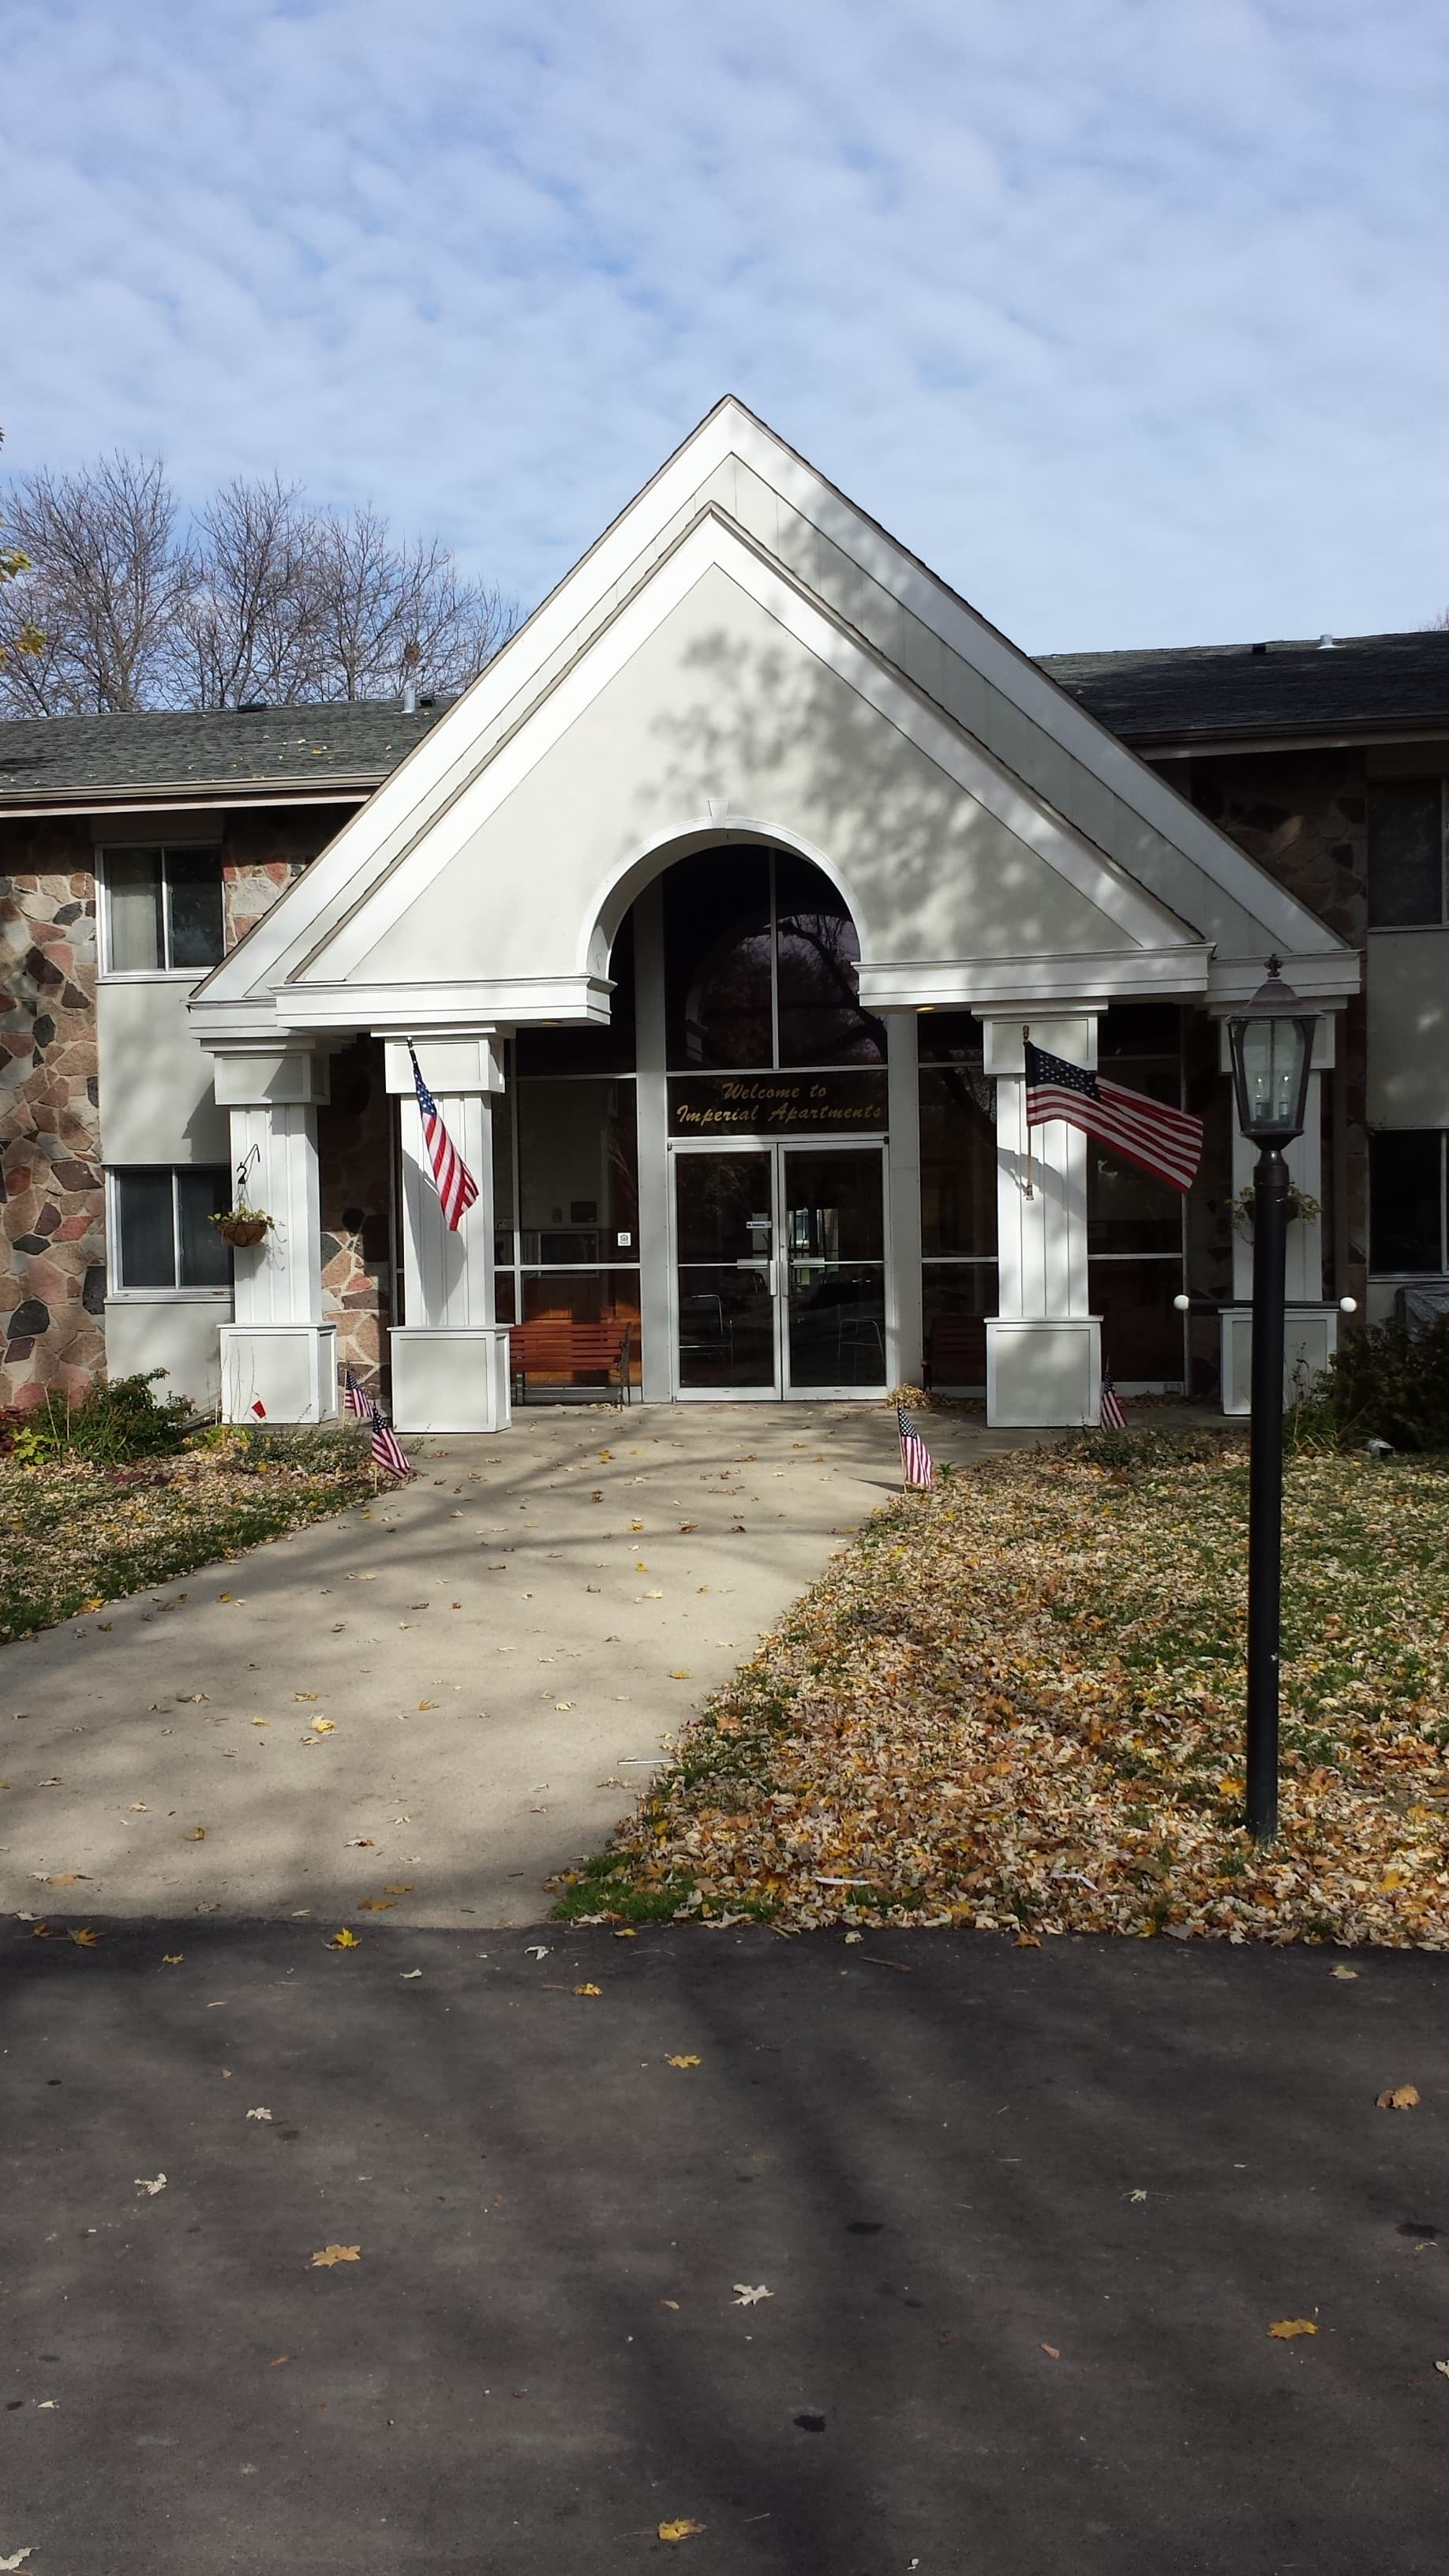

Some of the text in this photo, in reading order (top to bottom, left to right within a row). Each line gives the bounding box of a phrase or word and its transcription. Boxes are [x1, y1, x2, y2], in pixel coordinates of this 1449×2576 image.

[721, 1082, 827, 1099] Welcome to
[676, 1102, 882, 1126] Imperial Apartments
